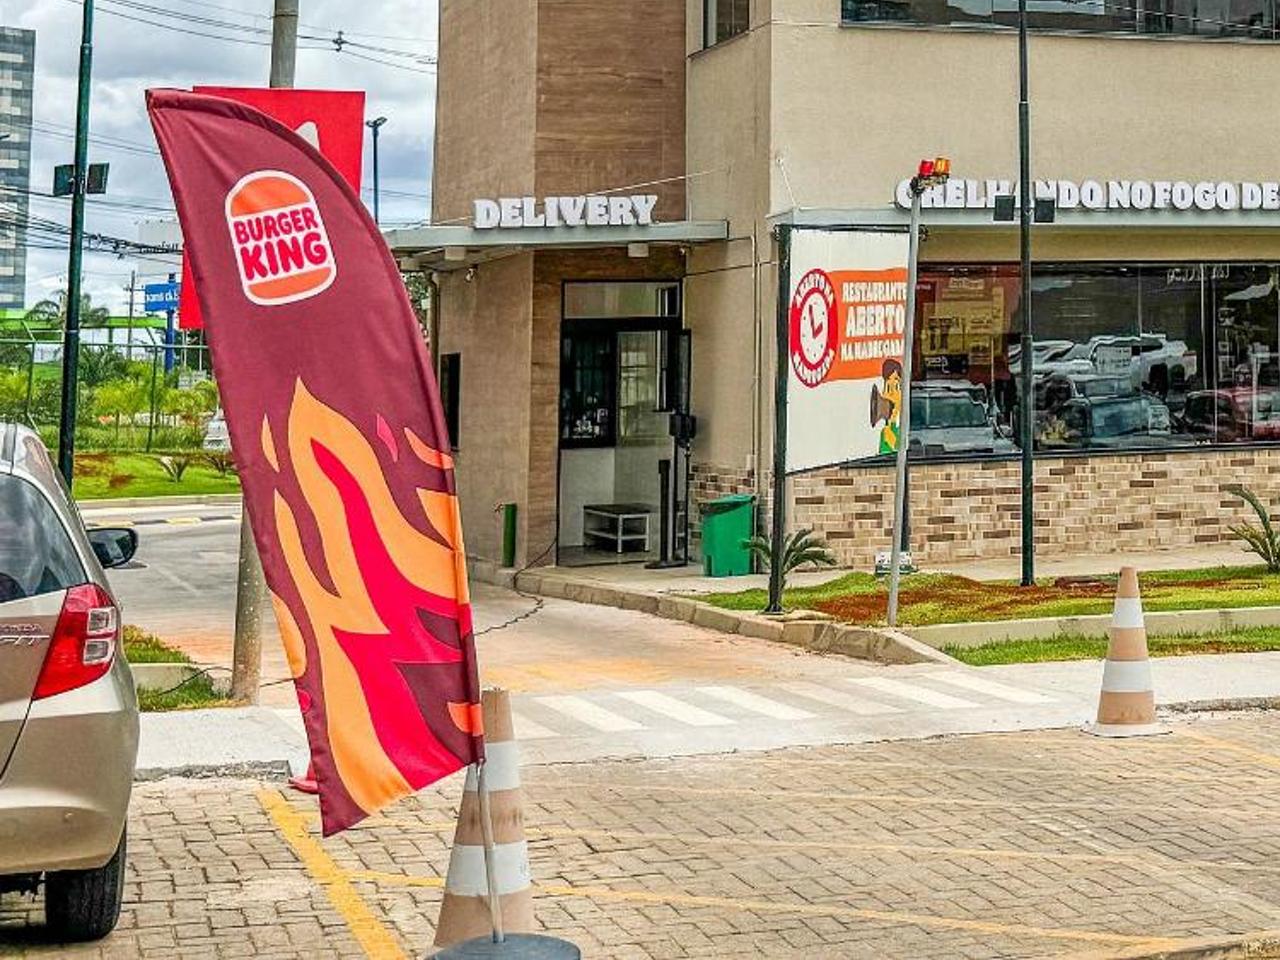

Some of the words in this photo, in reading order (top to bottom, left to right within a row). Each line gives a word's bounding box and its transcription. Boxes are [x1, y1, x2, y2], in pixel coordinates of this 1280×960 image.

[473, 194, 658, 229] DELIVERY
[1153, 181, 1238, 210] FOGO
[233, 206, 319, 245] BURGER
[240, 231, 327, 281] KING
[846, 304, 905, 337] ABERTO
